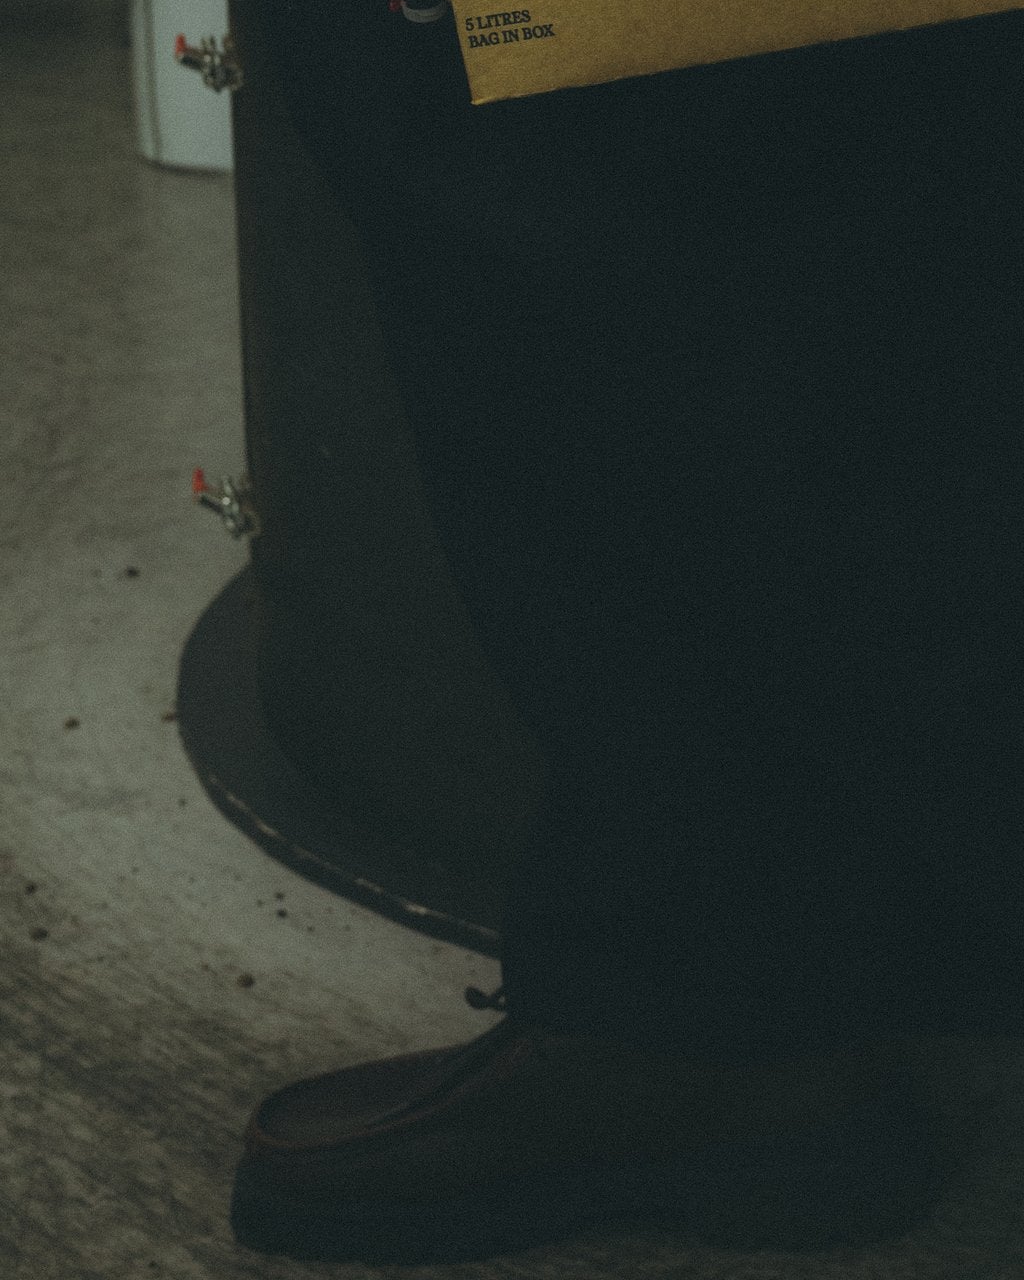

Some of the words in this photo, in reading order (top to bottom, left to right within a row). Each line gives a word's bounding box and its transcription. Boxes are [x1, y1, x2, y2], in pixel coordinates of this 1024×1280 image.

[465, 17, 475, 32] 5
[478, 9, 532, 30] LITRES
[468, 32, 500, 49] BAG
[502, 28, 520, 44] IN
[522, 24, 556, 40] BOX
